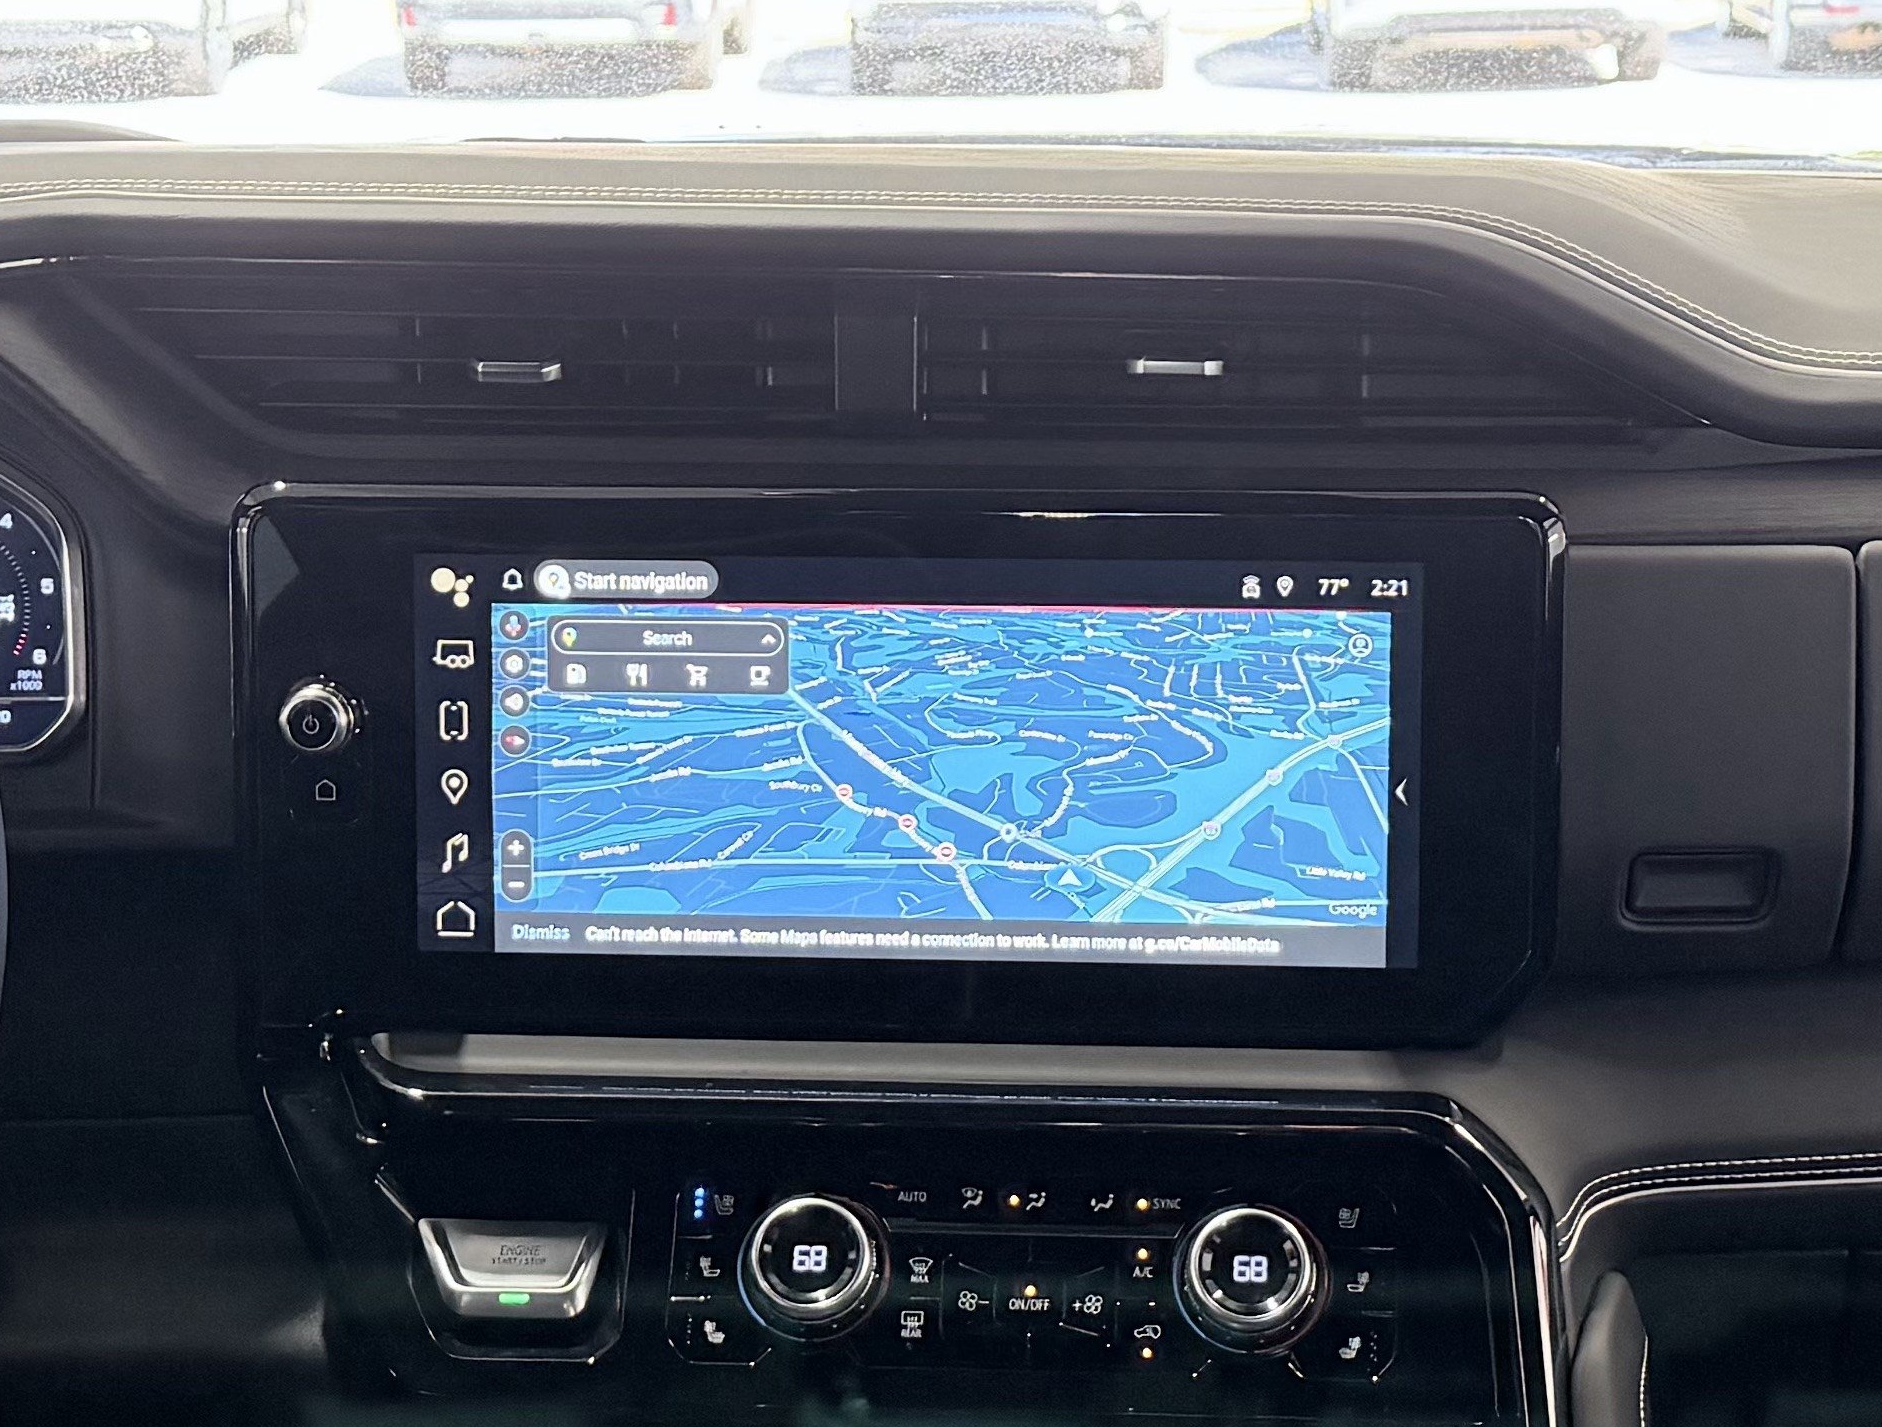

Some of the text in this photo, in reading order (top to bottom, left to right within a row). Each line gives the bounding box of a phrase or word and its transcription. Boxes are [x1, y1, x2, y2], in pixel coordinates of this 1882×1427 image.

[40, 577, 55, 595] 5
[574, 570, 708, 595] Start navigation
[1318, 578, 1350, 597] 77°
[1370, 578, 1409, 598] 2:21
[642, 630, 693, 647] Search
[32, 648, 47, 665] 6
[17, 669, 43, 680] RPM
[10, 680, 43, 691] x1000
[1328, 902, 1378, 920] Google
[511, 923, 570, 940] Dismiss
[620, 926, 658, 943] reach
[659, 927, 682, 943] the
[740, 928, 779, 945] Some
[781, 928, 817, 947] Maps
[819, 929, 874, 946] features
[875, 931, 909, 946] need
[911, 935, 921, 947] a
[922, 932, 995, 948] connection
[996, 934, 1012, 948] to
[1013, 933, 1050, 949] work.
[1051, 934, 1090, 950] Learn
[1091, 937, 1127, 950] more
[1128, 937, 1144, 951] at
[897, 1190, 927, 1203] AUTO
[1152, 1197, 1182, 1210] SYNC
[792, 1244, 828, 1273] 68
[1132, 1266, 1154, 1279] A/C
[1232, 1255, 1269, 1284] 68
[910, 1274, 930, 1284] MAX
[1008, 1298, 1051, 1312] ON/OFF
[900, 1328, 923, 1339] REAR
